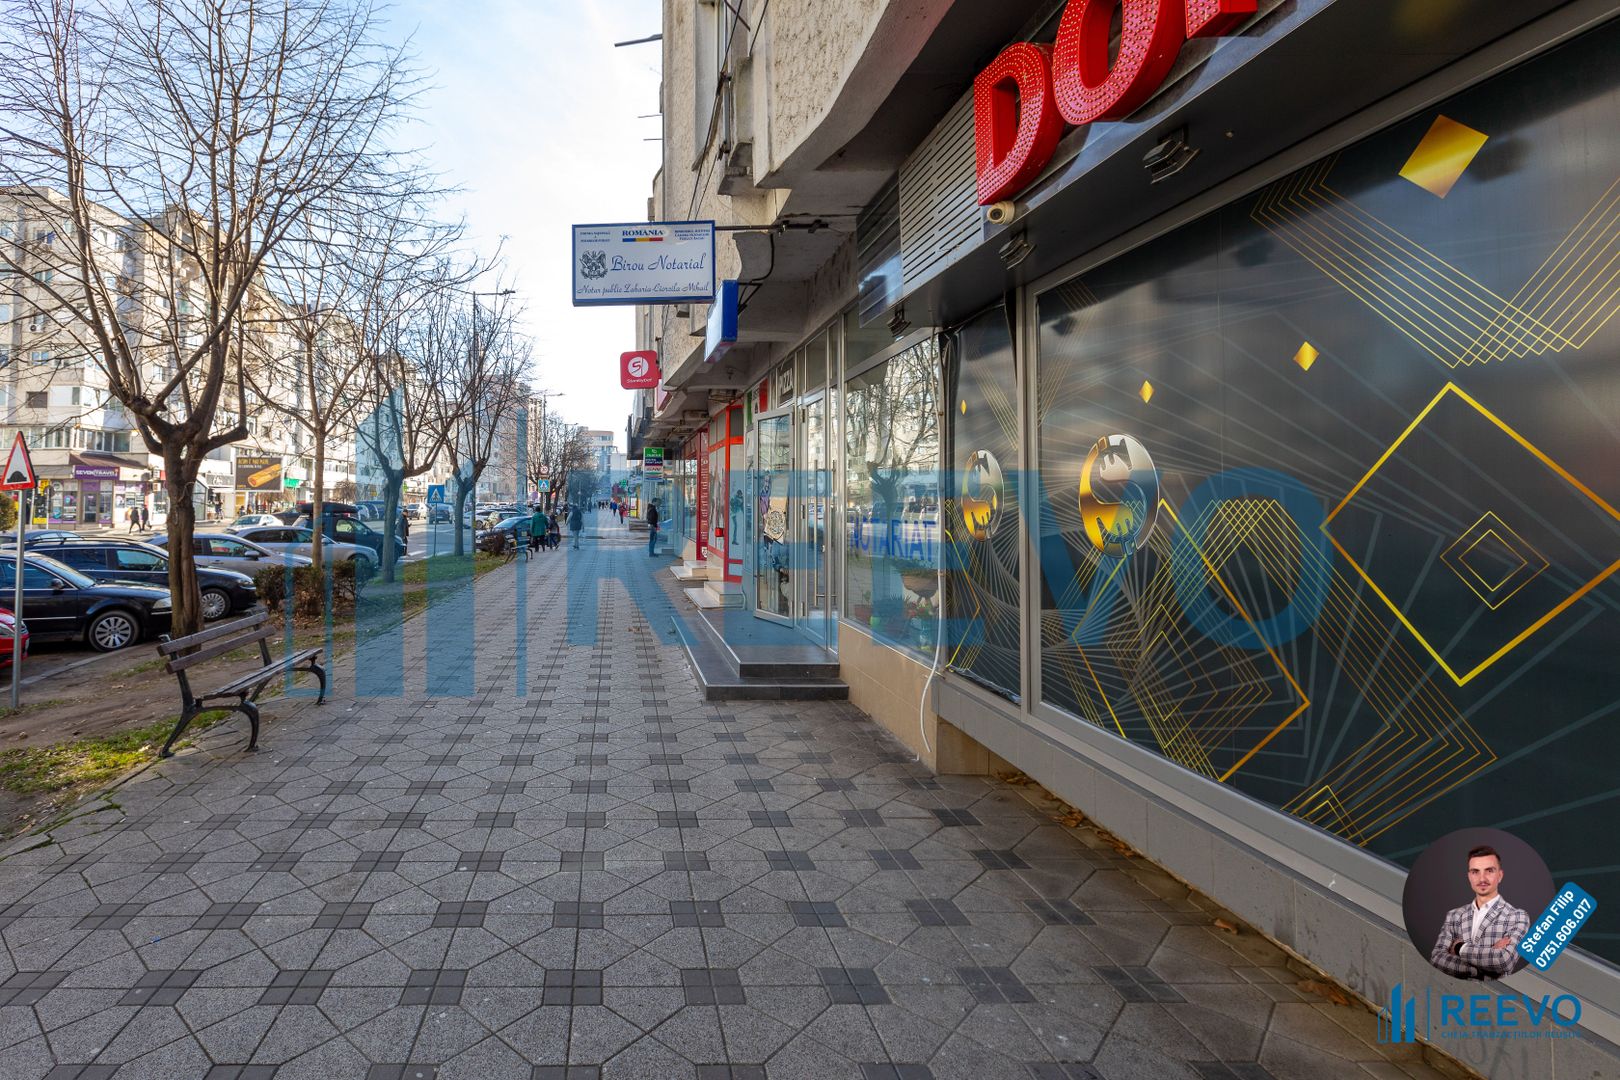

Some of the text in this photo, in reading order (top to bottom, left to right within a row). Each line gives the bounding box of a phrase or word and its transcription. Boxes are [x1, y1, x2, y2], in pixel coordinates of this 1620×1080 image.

[974, 0, 1258, 206] DO
[611, 252, 707, 271] Birou Notarial
[577, 285, 601, 294] Notar
[602, 283, 622, 295] public
[849, 515, 937, 562] NOTARIAT
